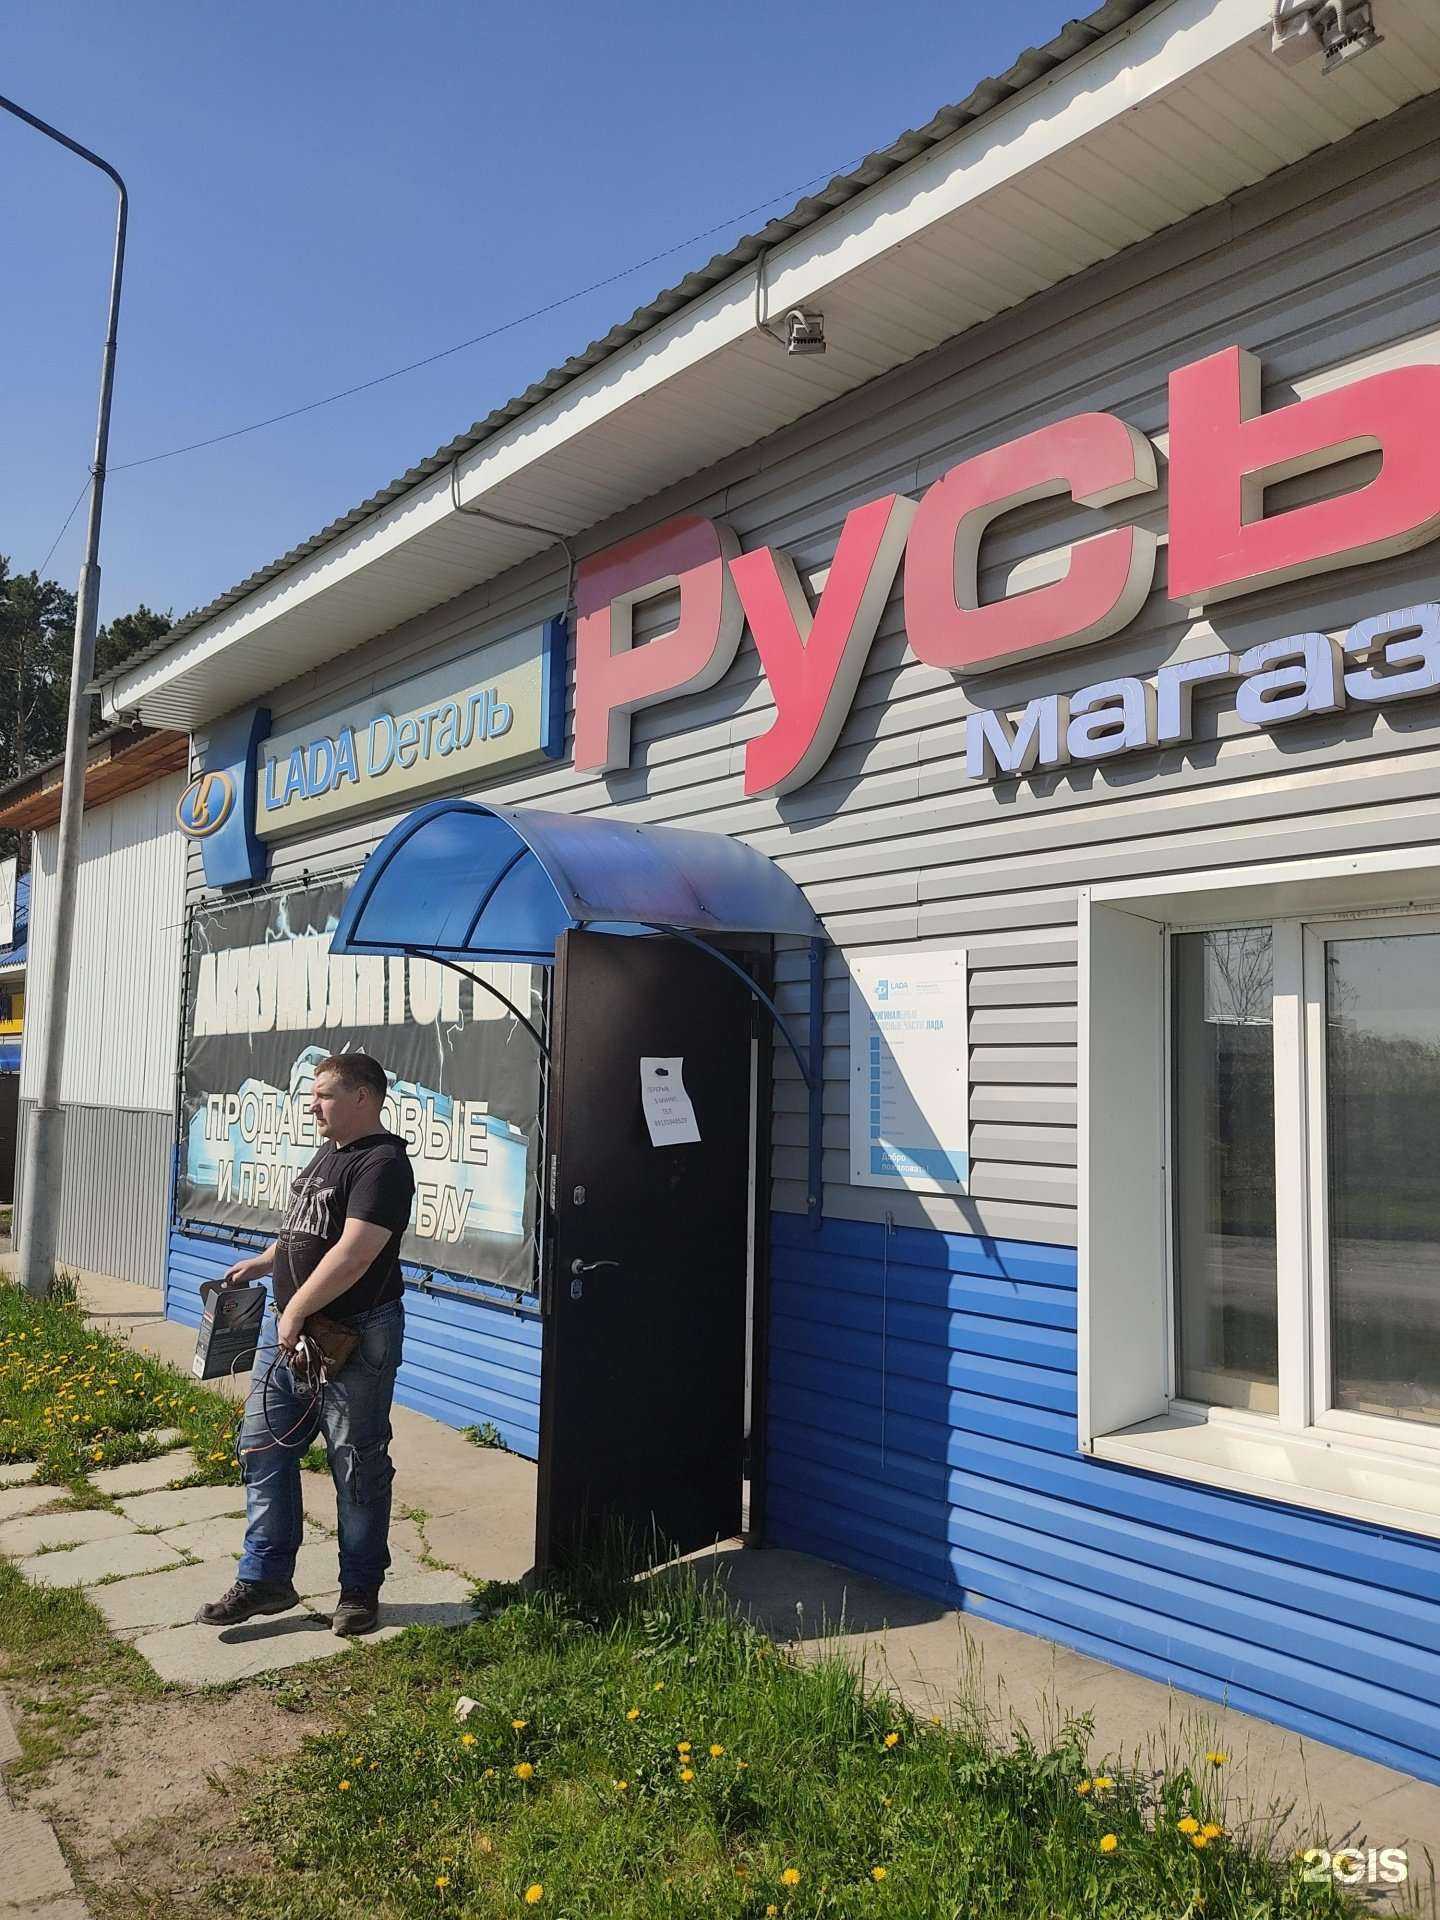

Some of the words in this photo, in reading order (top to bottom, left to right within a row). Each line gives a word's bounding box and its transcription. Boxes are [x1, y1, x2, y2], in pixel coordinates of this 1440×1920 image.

[265, 727, 360, 811] LADA
[205, 1091, 323, 1155] ПРОДАЕ
[380, 1095, 489, 1166] ОВЫЕ
[217, 1159, 233, 1203] И
[415, 1181, 474, 1243] Б/У
